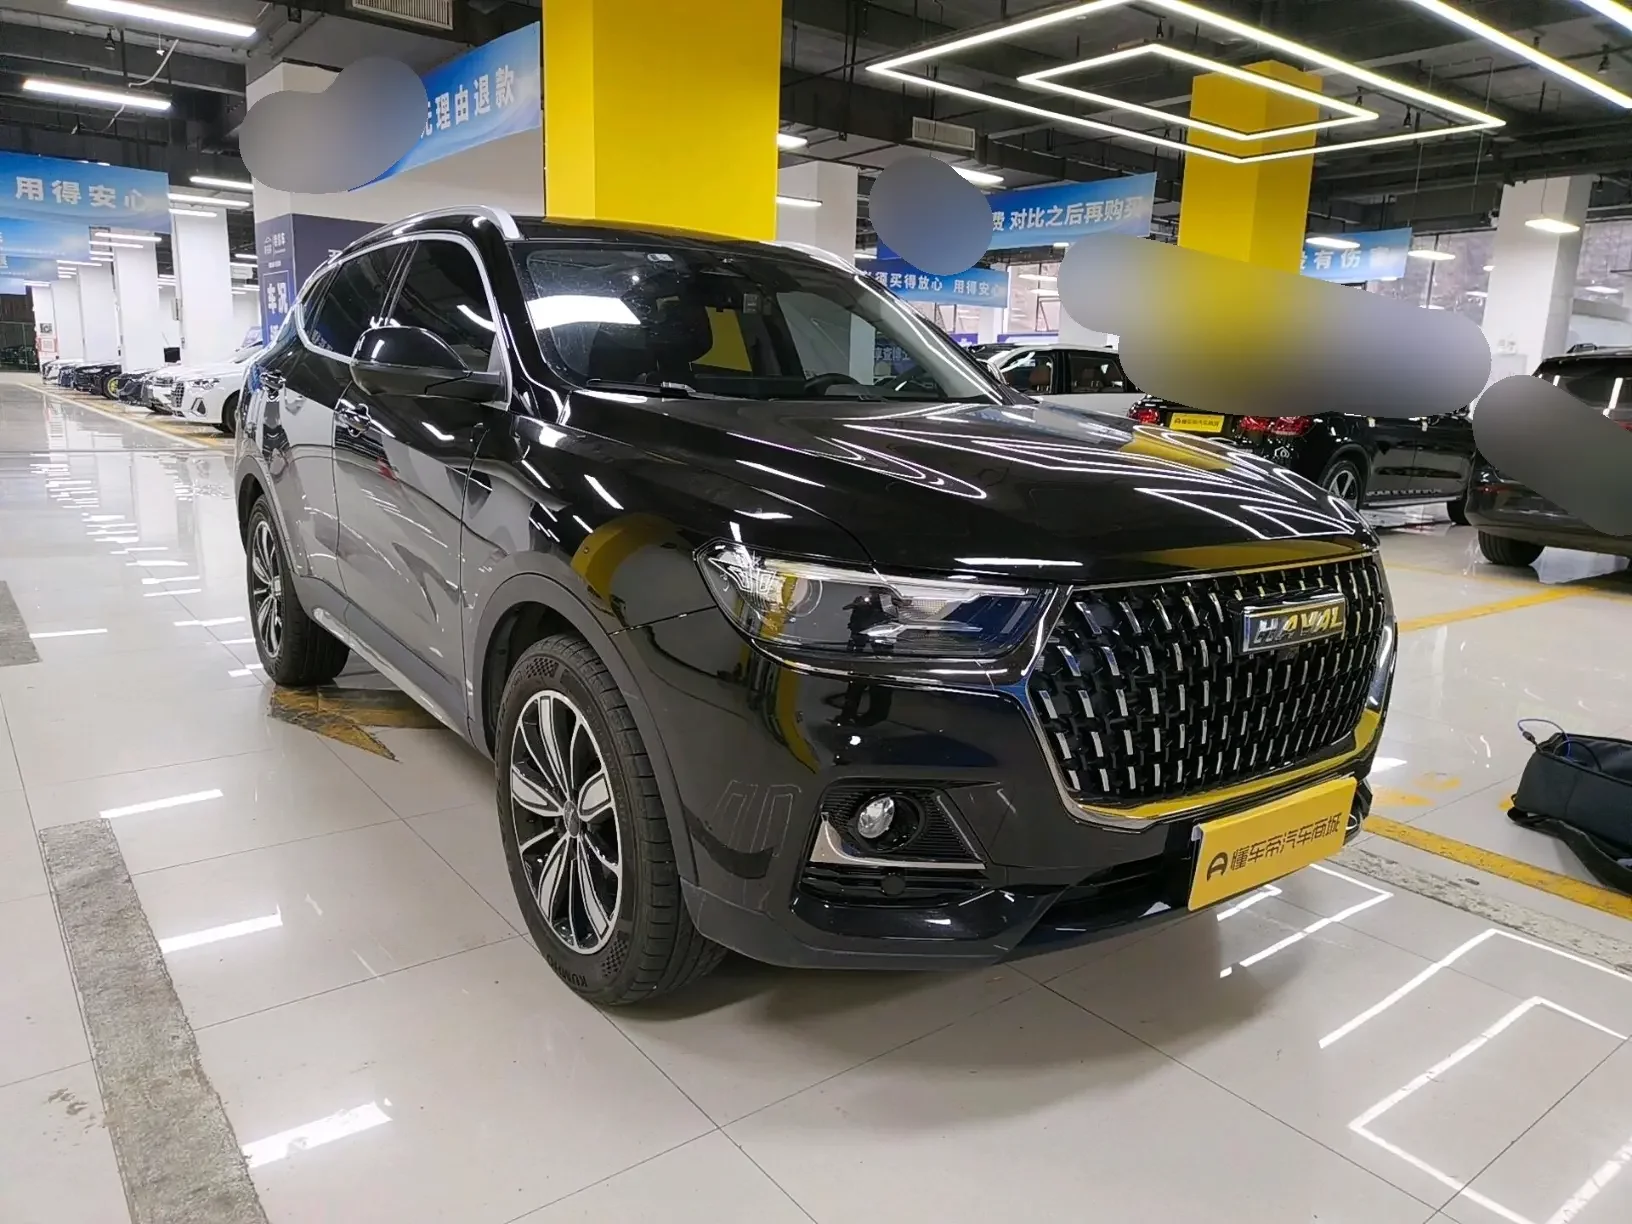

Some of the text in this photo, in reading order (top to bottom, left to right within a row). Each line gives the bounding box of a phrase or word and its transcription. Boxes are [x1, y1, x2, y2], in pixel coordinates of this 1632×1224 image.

[15, 176, 146, 211] 用得安心
[1009, 196, 1143, 230] 对比之后再购买
[1253, 606, 1343, 644] HAVAL
[1231, 812, 1342, 871] 懂车帝汽车商城
